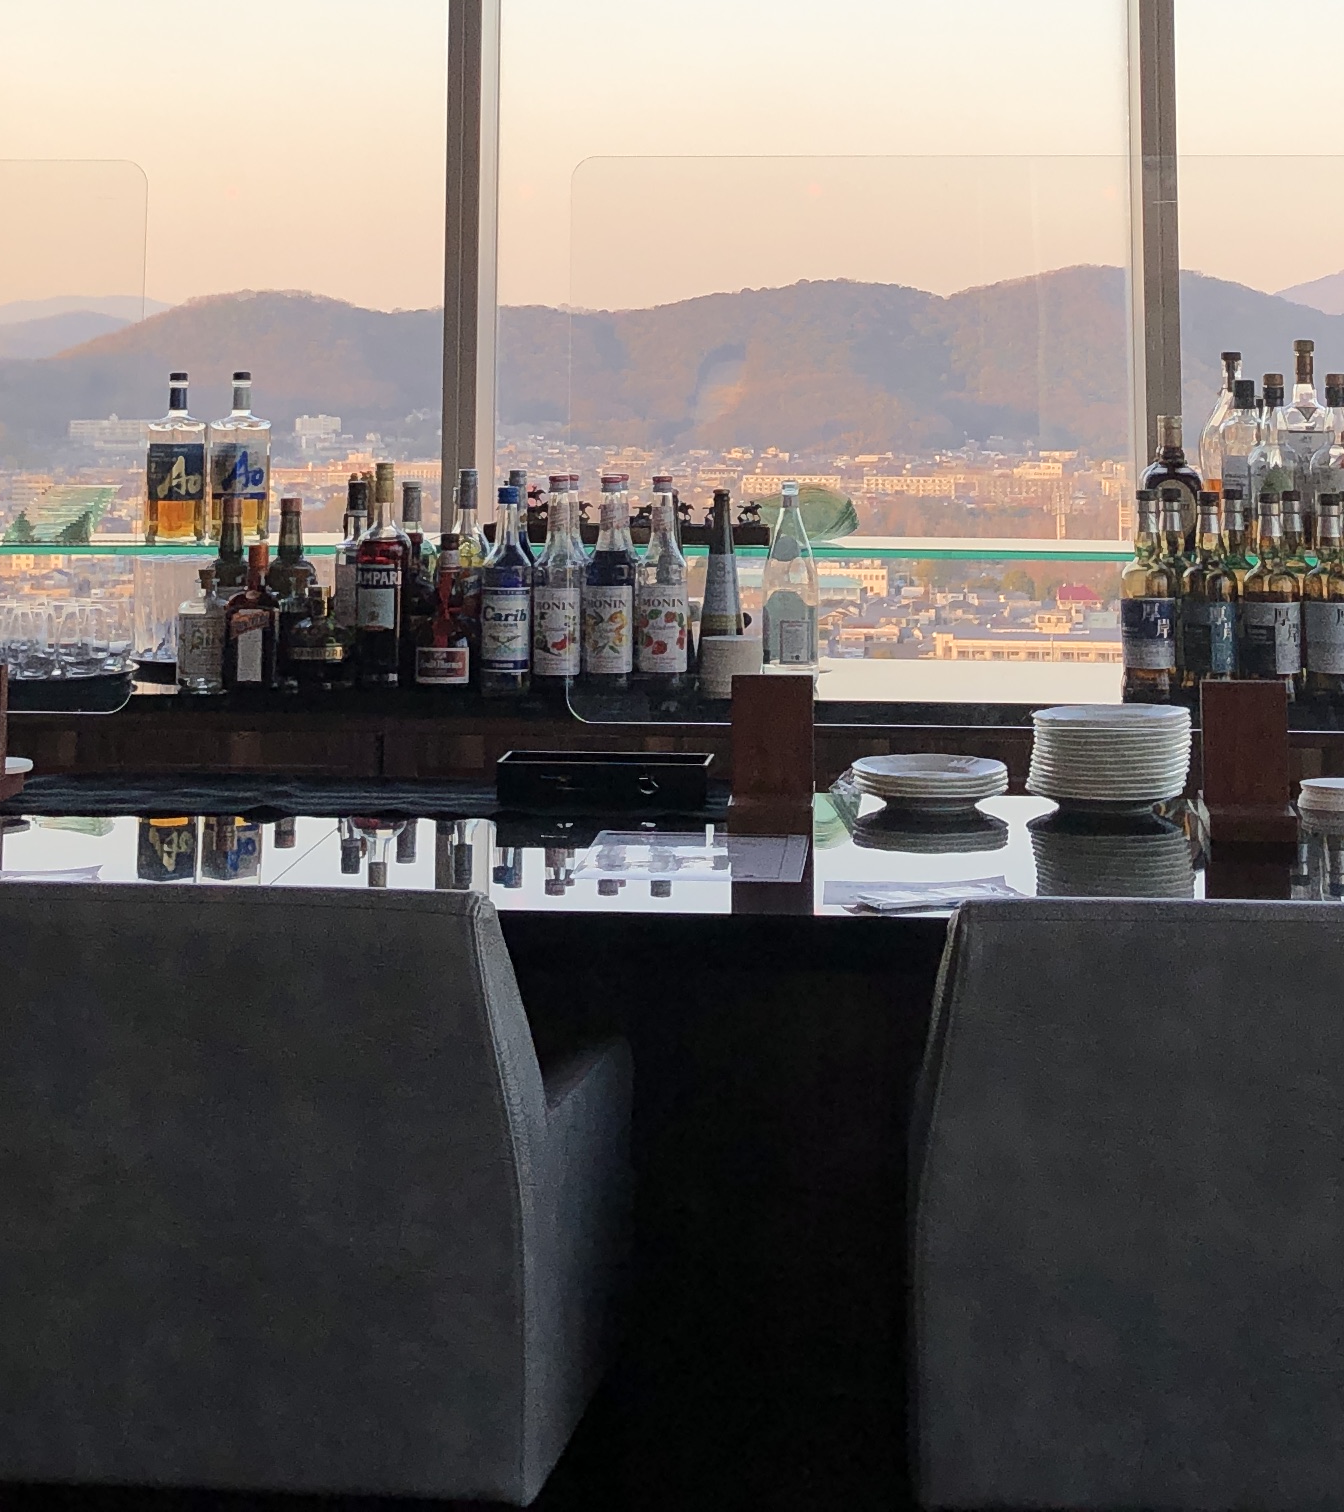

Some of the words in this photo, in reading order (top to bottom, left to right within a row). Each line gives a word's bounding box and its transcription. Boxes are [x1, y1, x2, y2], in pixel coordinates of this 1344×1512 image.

[157, 455, 203, 499] Ao
[221, 450, 265, 492] Ao
[643, 598, 684, 608] MONIN
